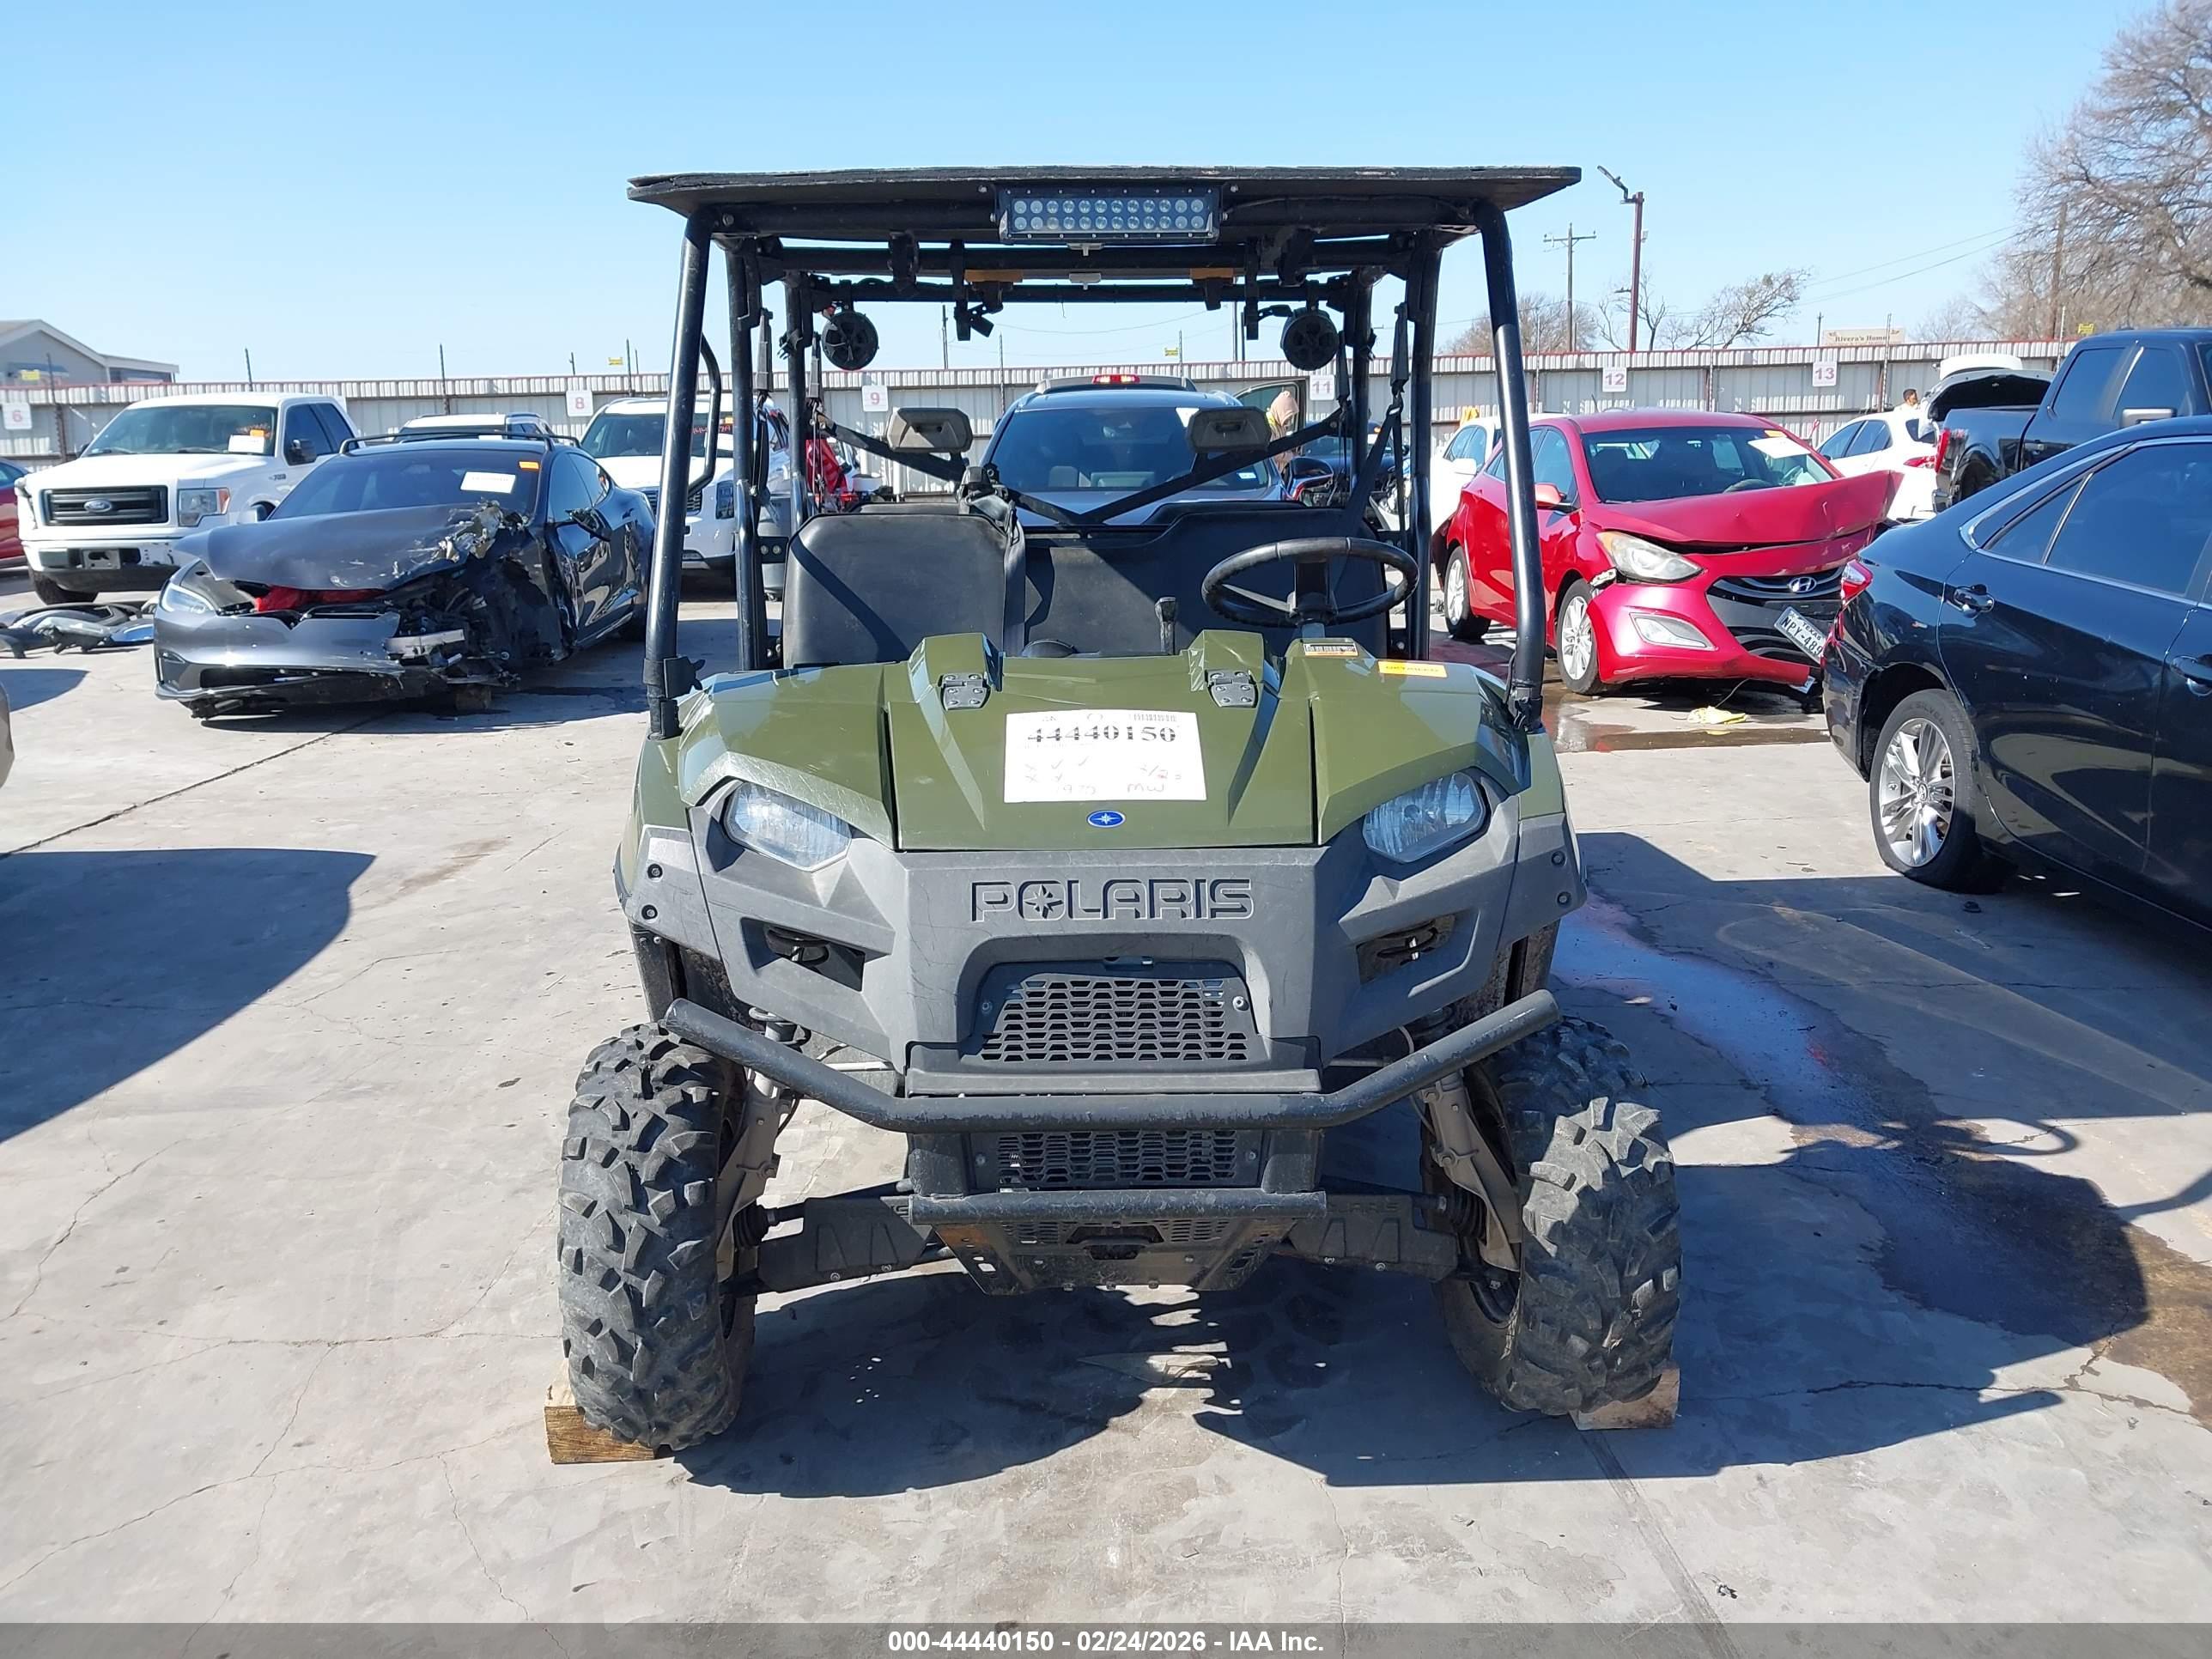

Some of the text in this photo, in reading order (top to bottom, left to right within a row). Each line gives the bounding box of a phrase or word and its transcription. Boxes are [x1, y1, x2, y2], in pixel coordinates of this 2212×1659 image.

[1606, 373, 1625, 386] 12
[1814, 368, 1835, 380] 13
[1313, 380, 1330, 394] 11
[575, 398, 585, 410] 8
[870, 392, 880, 405] 9
[13, 410, 22, 422] 6
[1802, 622, 1821, 641] TEXAS
[1028, 725, 1176, 743] 44440150
[971, 878, 1255, 923] POLARIS
